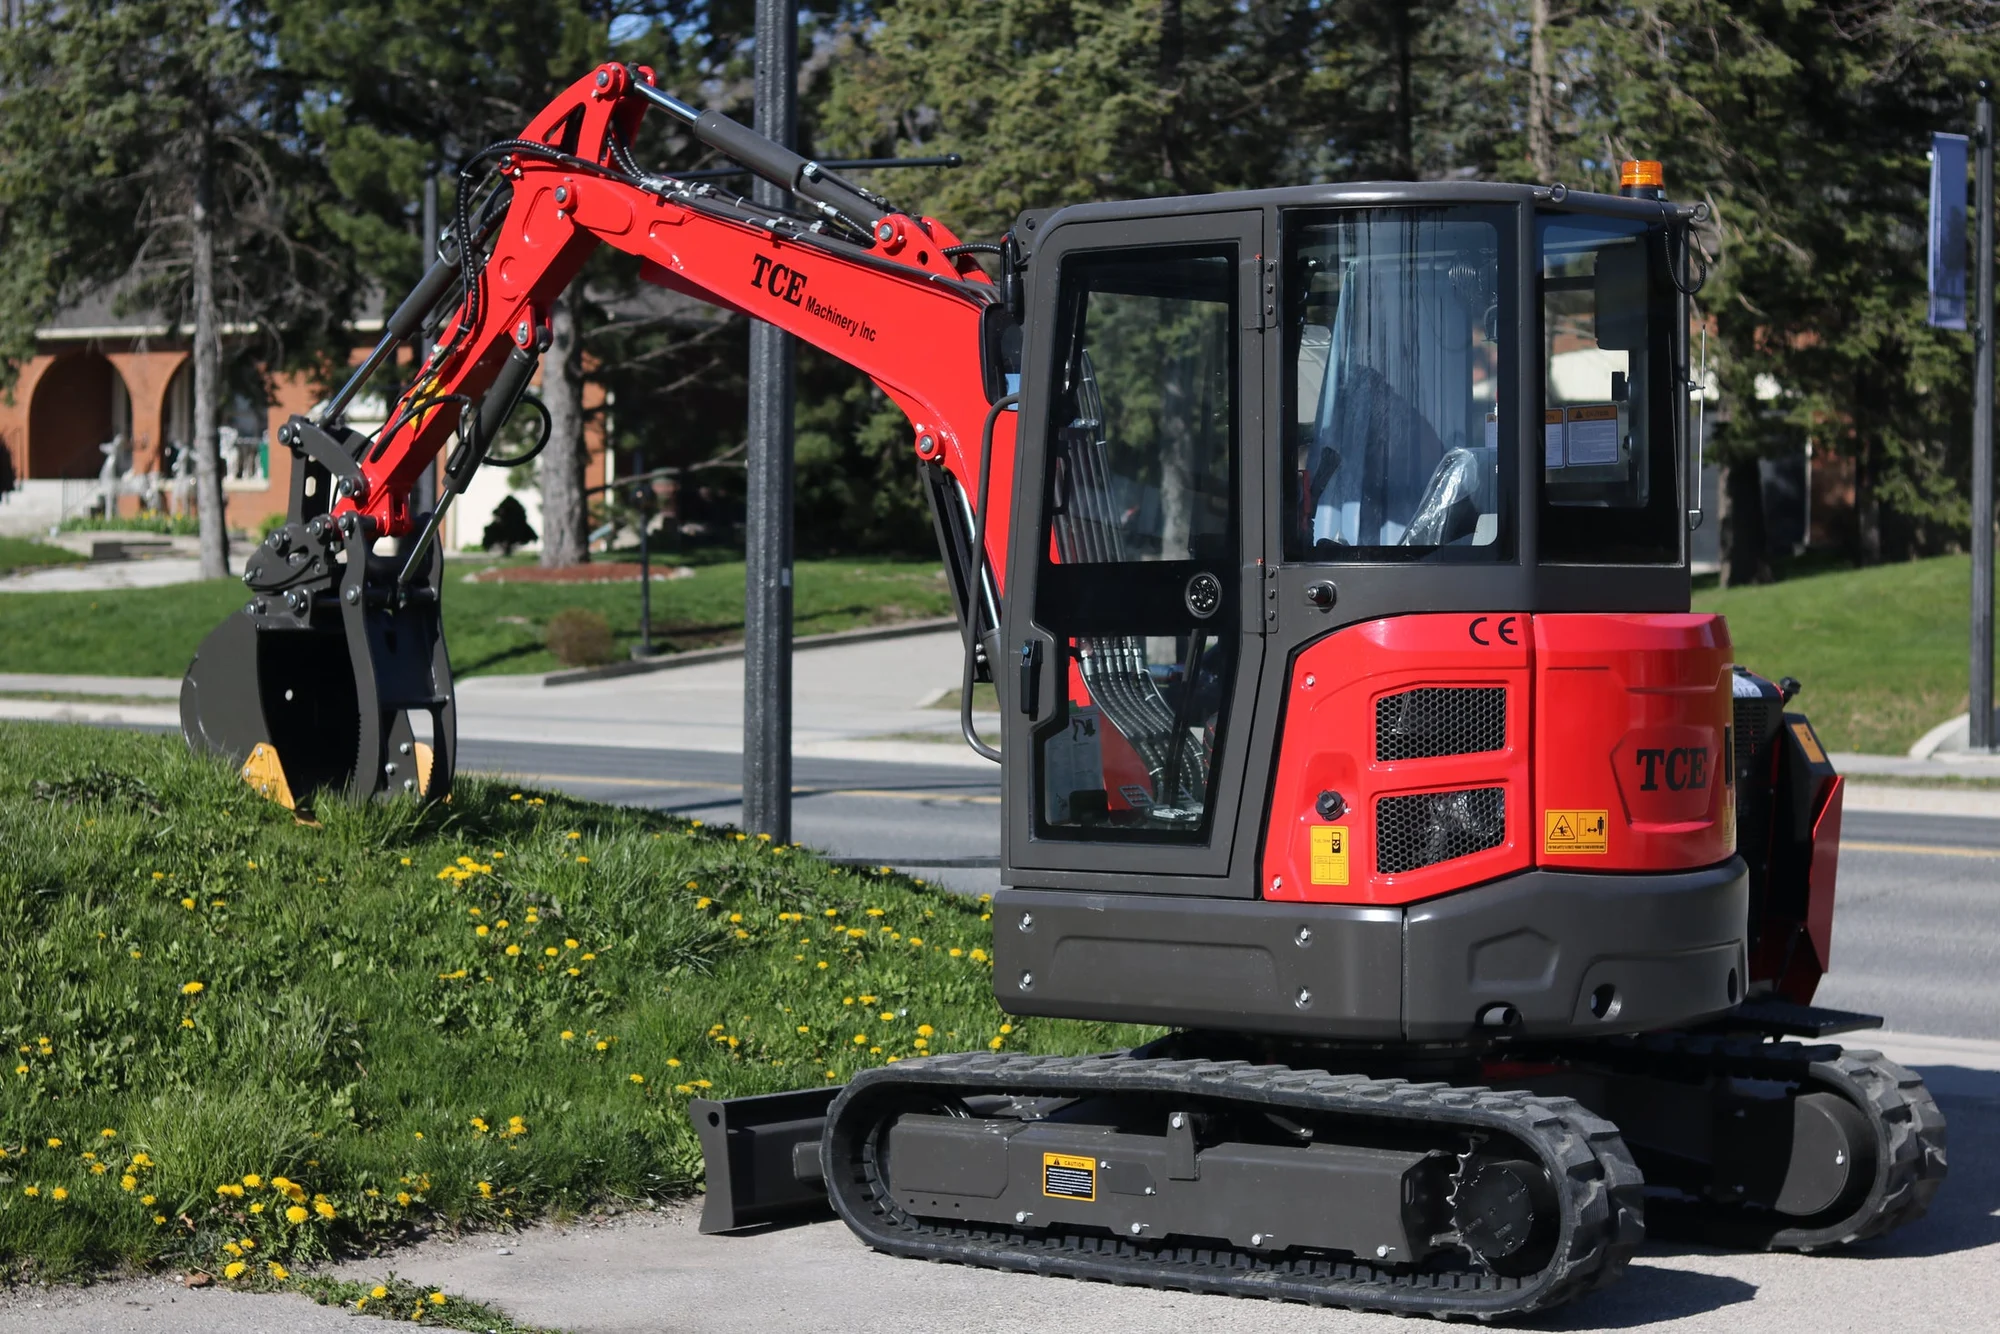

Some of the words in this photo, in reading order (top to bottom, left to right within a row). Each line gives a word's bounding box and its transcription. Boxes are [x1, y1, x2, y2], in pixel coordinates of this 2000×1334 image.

[751, 253, 808, 307] TCE
[805, 295, 859, 337] Machinery
[859, 321, 877, 342] Inc
[1469, 617, 1518, 645] CE
[1636, 748, 1708, 791] TCE
